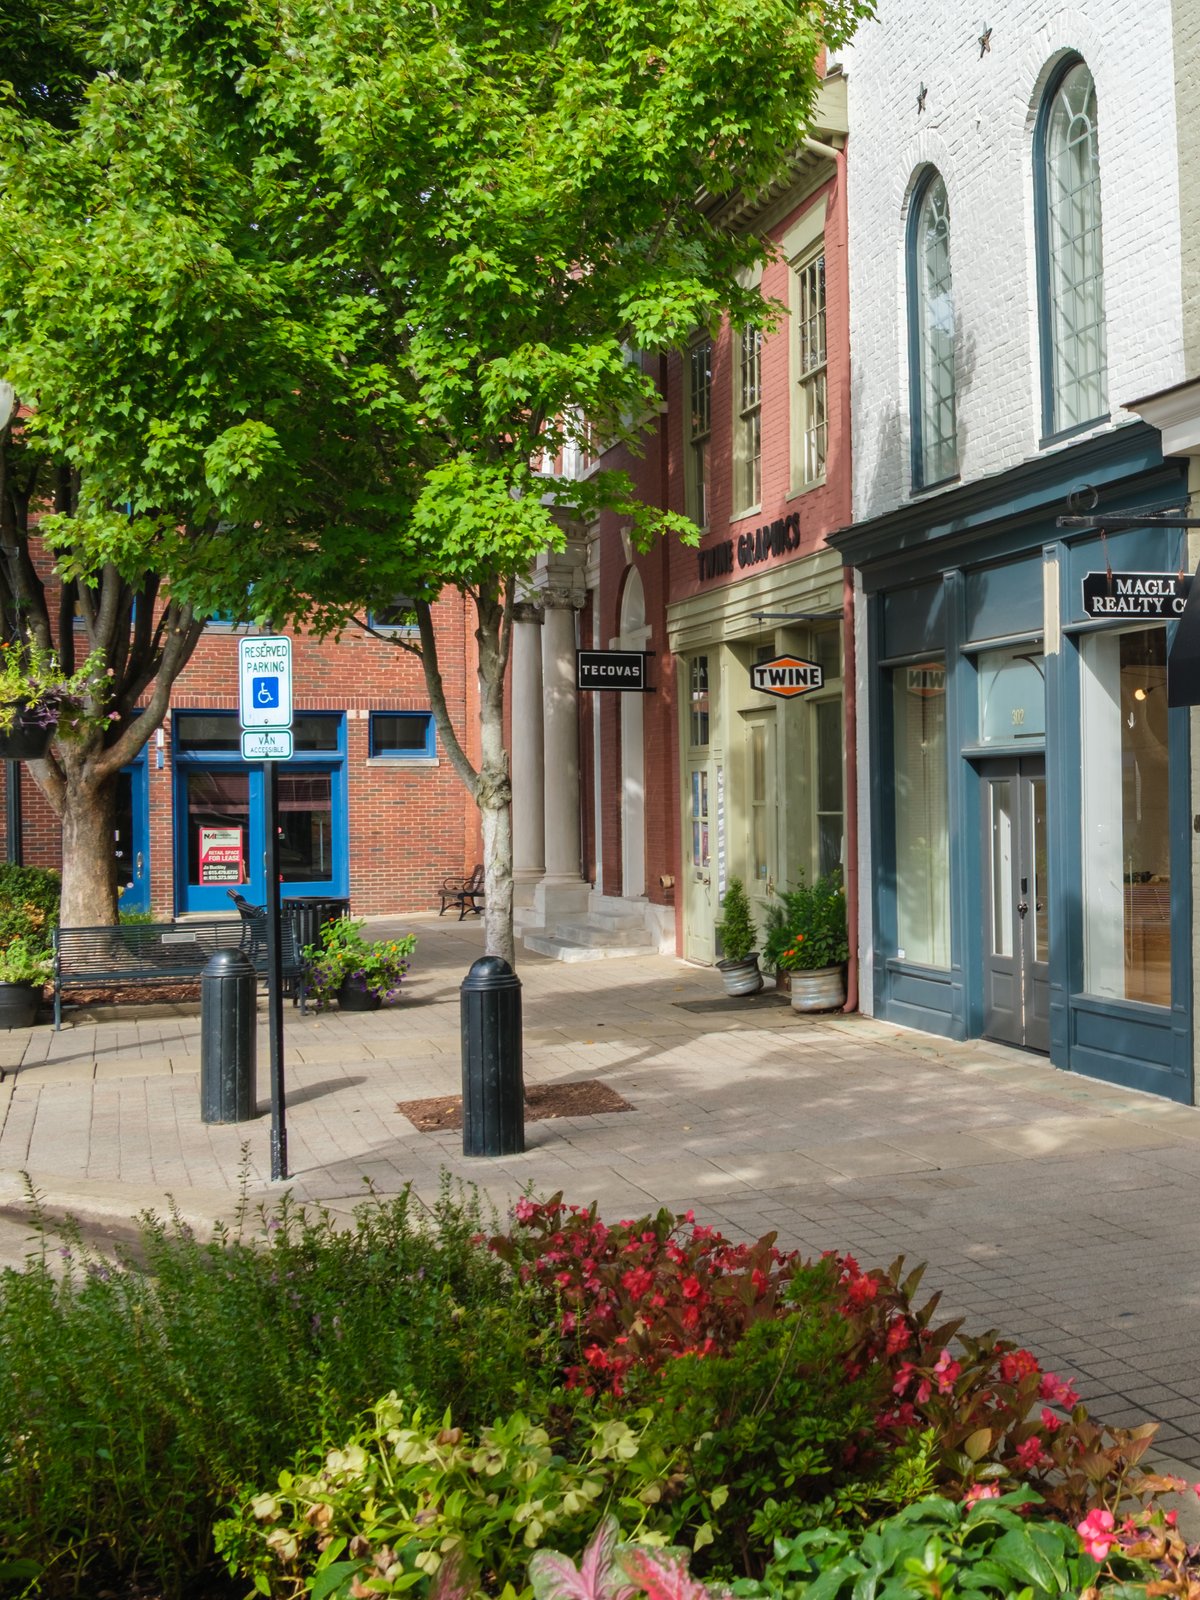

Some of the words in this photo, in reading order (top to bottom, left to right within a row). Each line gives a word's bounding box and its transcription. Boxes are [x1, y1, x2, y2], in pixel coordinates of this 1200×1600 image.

[1117, 579, 1176, 596] MAGLI
[1092, 596, 1164, 613] REALTY
[1172, 597, 1188, 613] C
[245, 645, 287, 658] RESERVED
[247, 661, 285, 672] PARKING
[582, 665, 640, 676] TECOVAS
[756, 668, 819, 686] TWINE
[1012, 708, 1025, 725] 302
[259, 737, 276, 745] VAN
